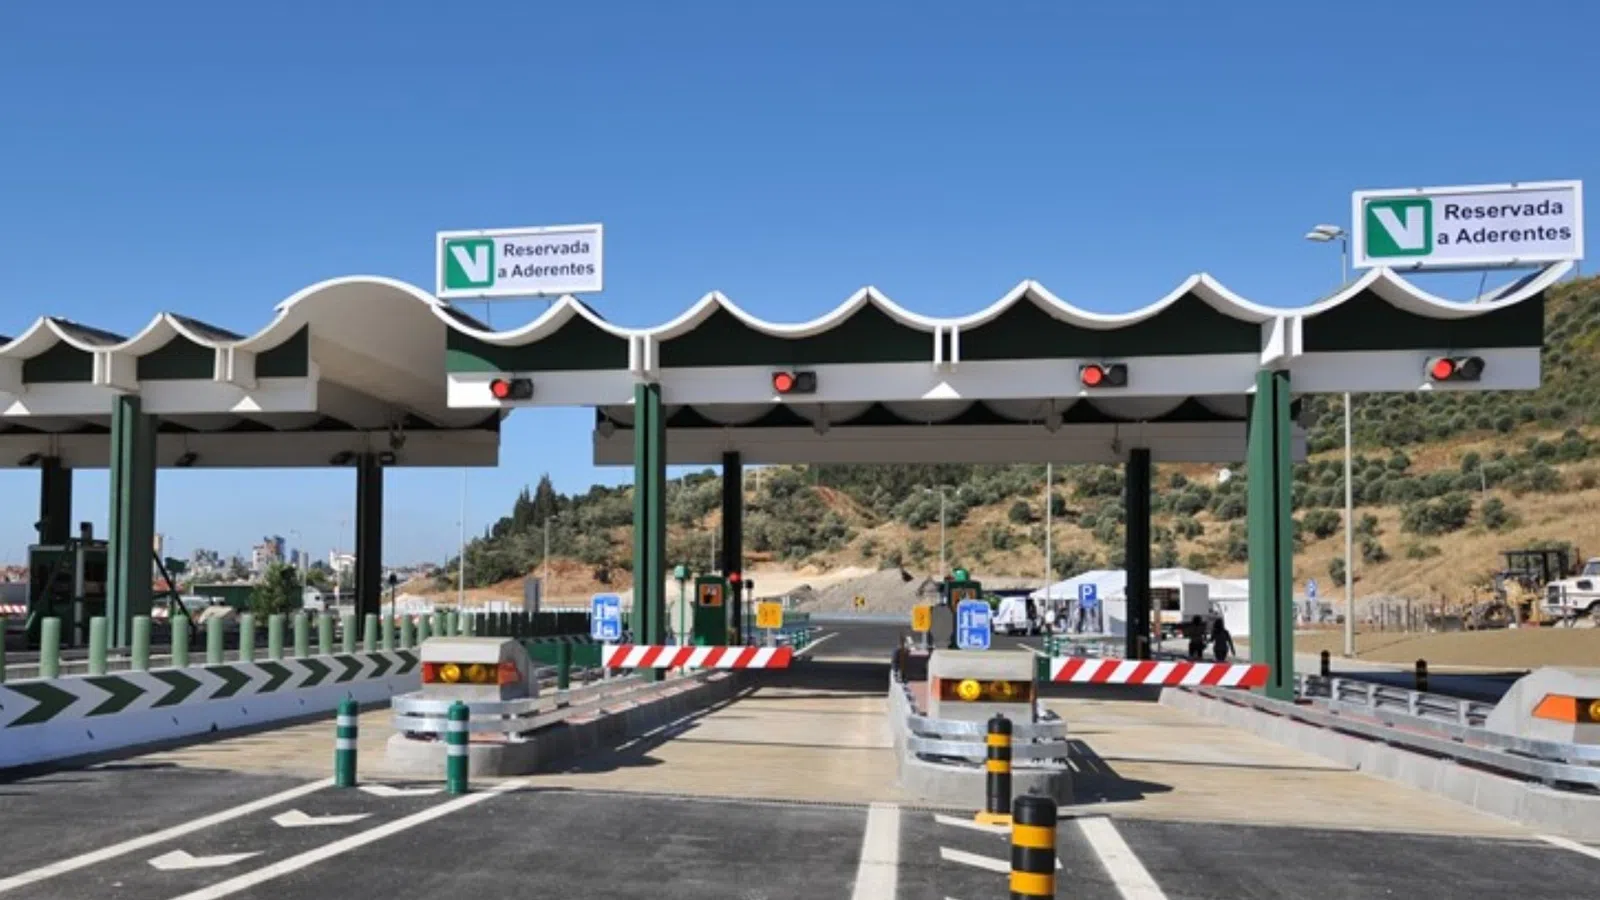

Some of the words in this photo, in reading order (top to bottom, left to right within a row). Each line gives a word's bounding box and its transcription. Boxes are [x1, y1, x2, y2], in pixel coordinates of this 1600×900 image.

[1444, 200, 1563, 220] Reservada
[1437, 232, 1449, 245] a
[1456, 226, 1571, 244] Aderentes
[504, 240, 589, 257] Reservada
[498, 268, 507, 278] a
[511, 263, 594, 278] Aderentes
